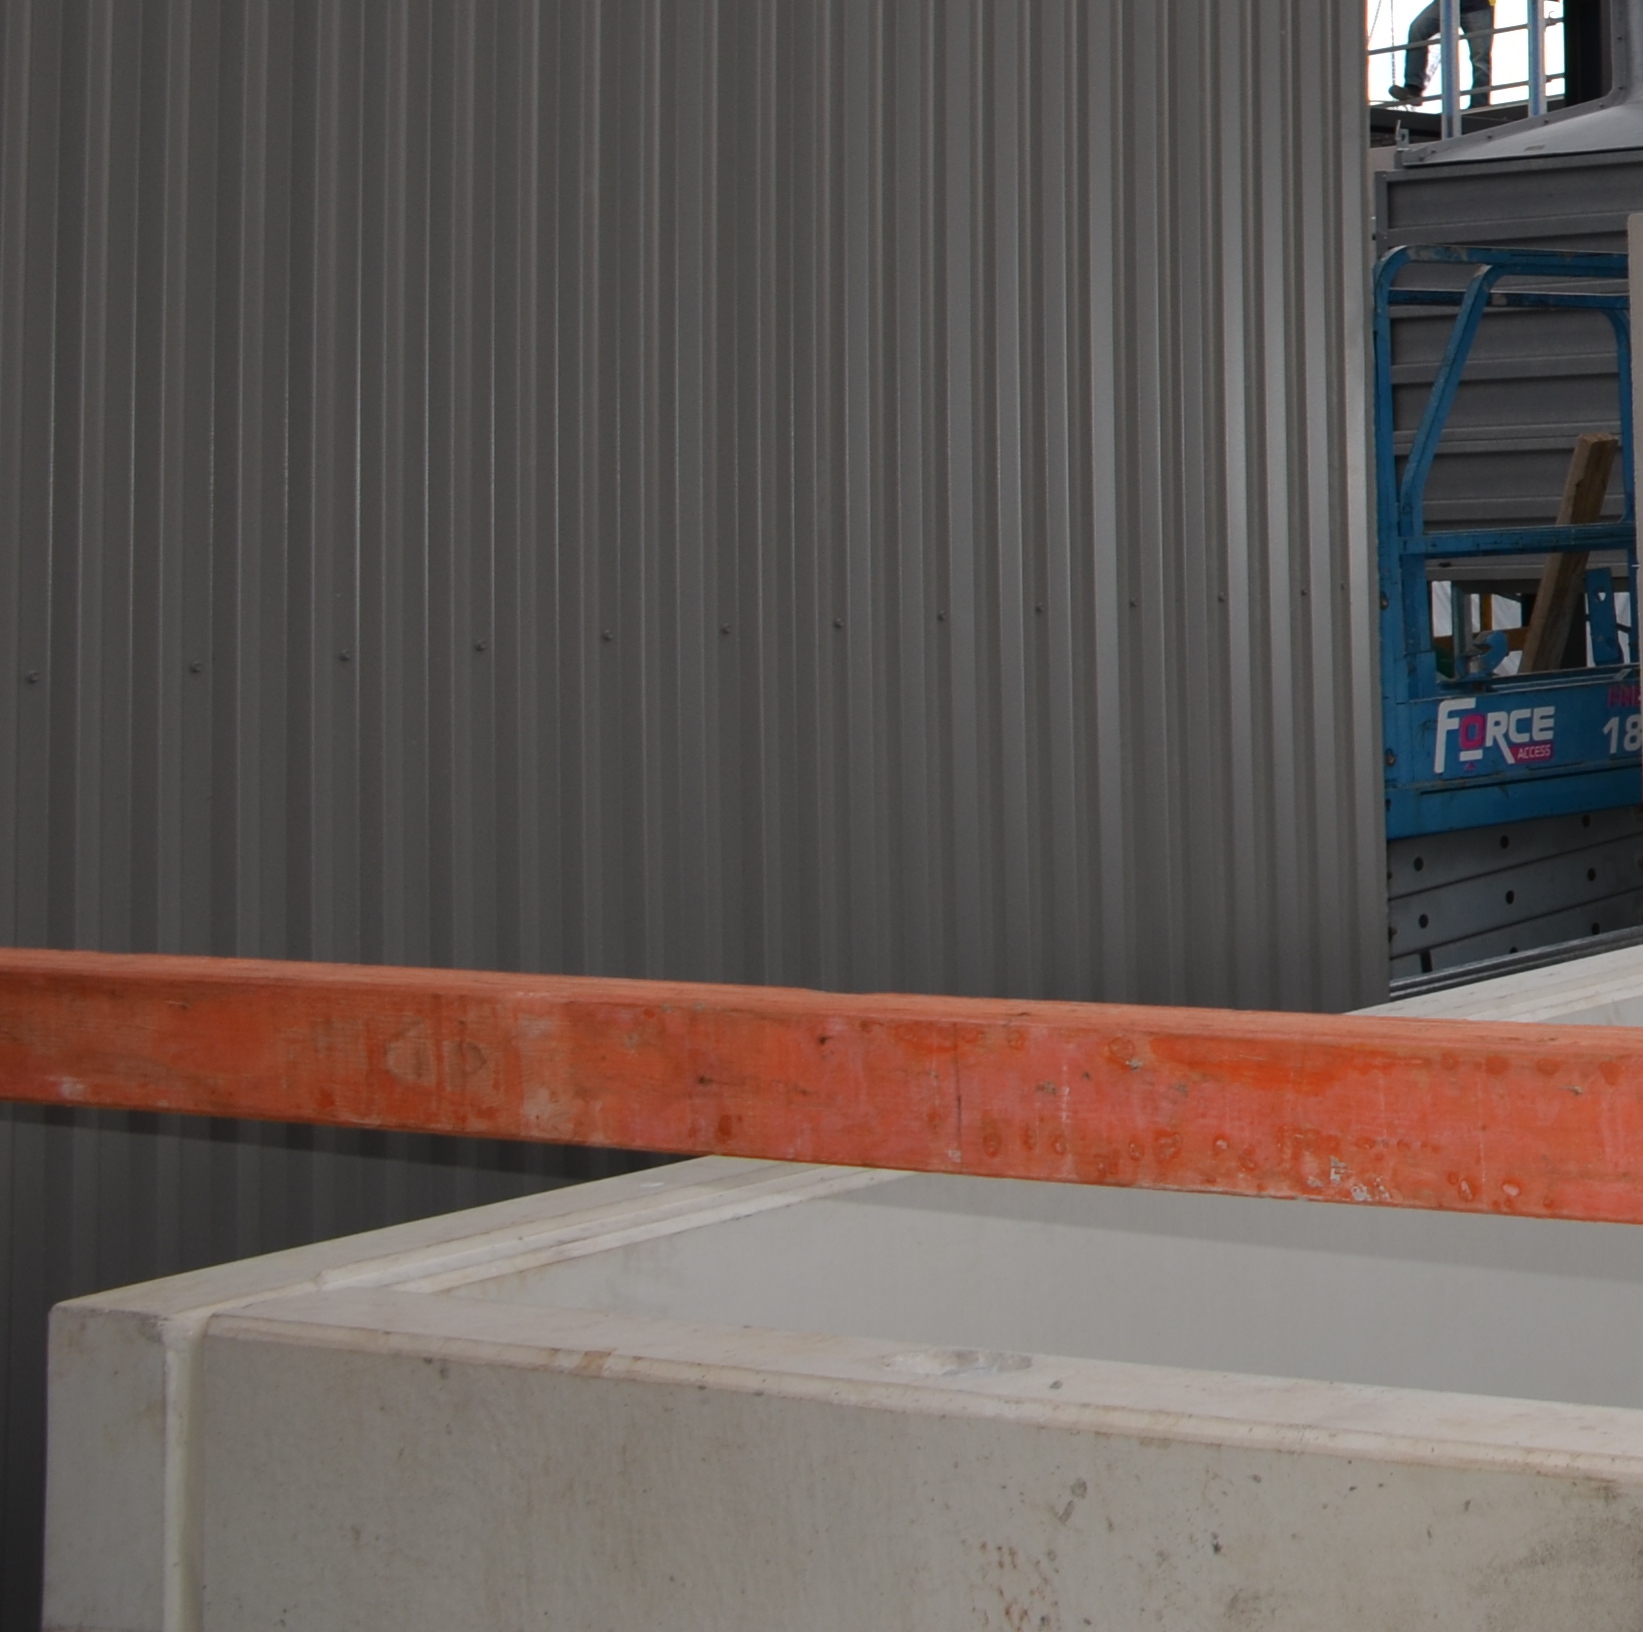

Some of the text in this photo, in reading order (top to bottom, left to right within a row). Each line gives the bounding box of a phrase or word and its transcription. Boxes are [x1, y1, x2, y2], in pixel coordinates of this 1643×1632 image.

[1433, 697, 1556, 774] FORCE
[1516, 744, 1552, 761] ACCESS
[1602, 714, 1642, 754] 18
